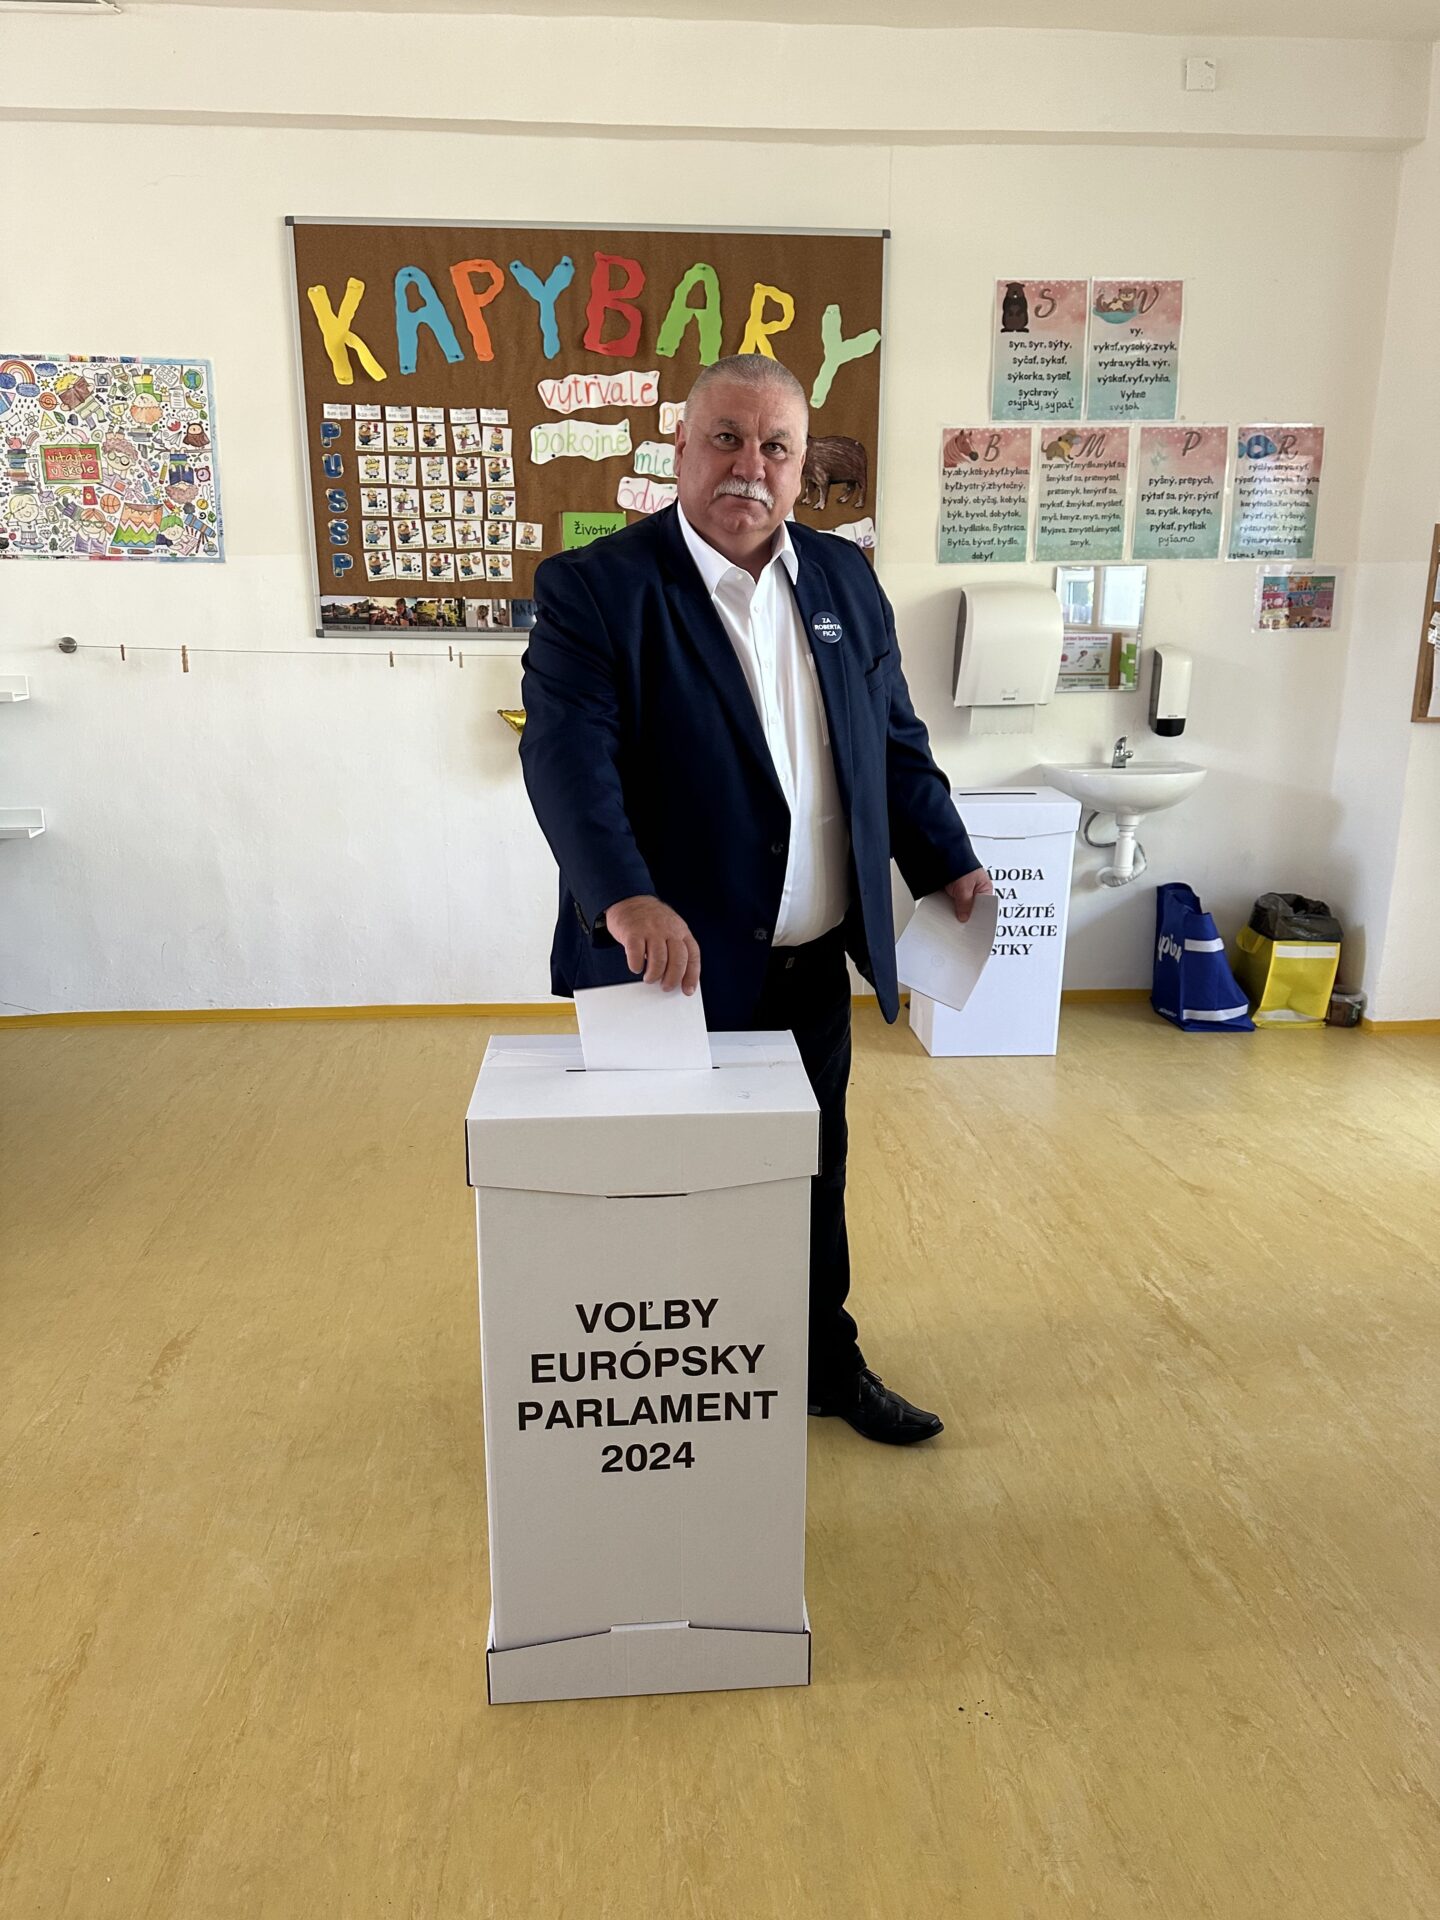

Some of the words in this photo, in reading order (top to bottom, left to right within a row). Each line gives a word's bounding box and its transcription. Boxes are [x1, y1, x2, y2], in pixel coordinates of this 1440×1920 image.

[1034, 288, 1056, 318] S
[1137, 286, 1159, 314] V
[308, 252, 881, 409] KAPYBARY
[984, 434, 1002, 462] B
[1075, 433, 1106, 458] M
[1182, 431, 1202, 456] P
[1278, 434, 1298, 460] R
[48, 450, 93, 466] vitajte
[62, 463, 95, 478] škole
[987, 866, 1044, 880] ÁDOBA
[996, 925, 1058, 937] OVACIE
[991, 944, 1032, 956] STKY
[575, 1298, 719, 1334] VOĽBY
[531, 1341, 765, 1384] EURÓPSKY
[518, 1391, 778, 1431] PARLAMENT
[601, 1441, 695, 1473] 2024
